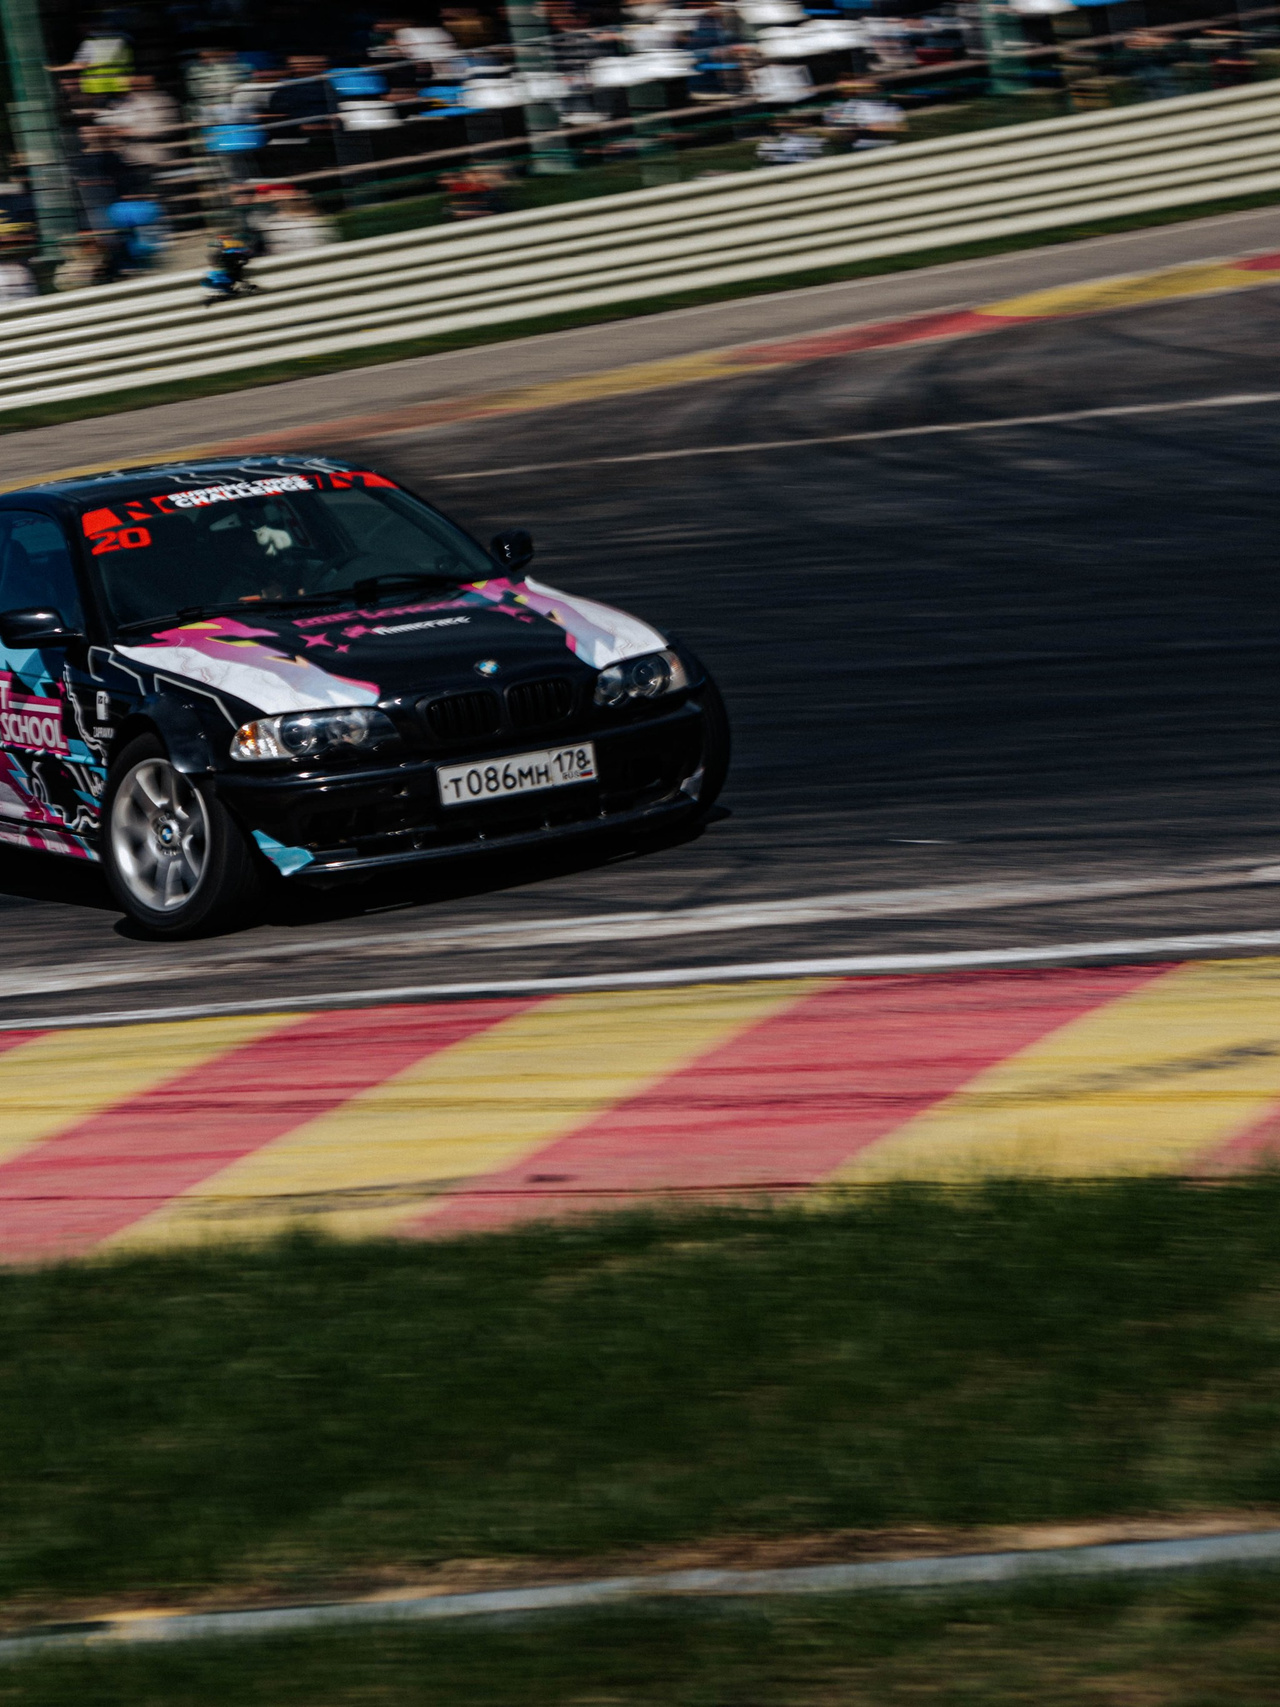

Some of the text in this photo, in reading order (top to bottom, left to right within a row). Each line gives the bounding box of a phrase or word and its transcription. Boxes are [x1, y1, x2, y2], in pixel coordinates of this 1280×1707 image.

[175, 480, 314, 508] CHALLENGE
[89, 527, 151, 555] 20
[0, 712, 67, 749] SCHOOL
[553, 749, 588, 773] 178
